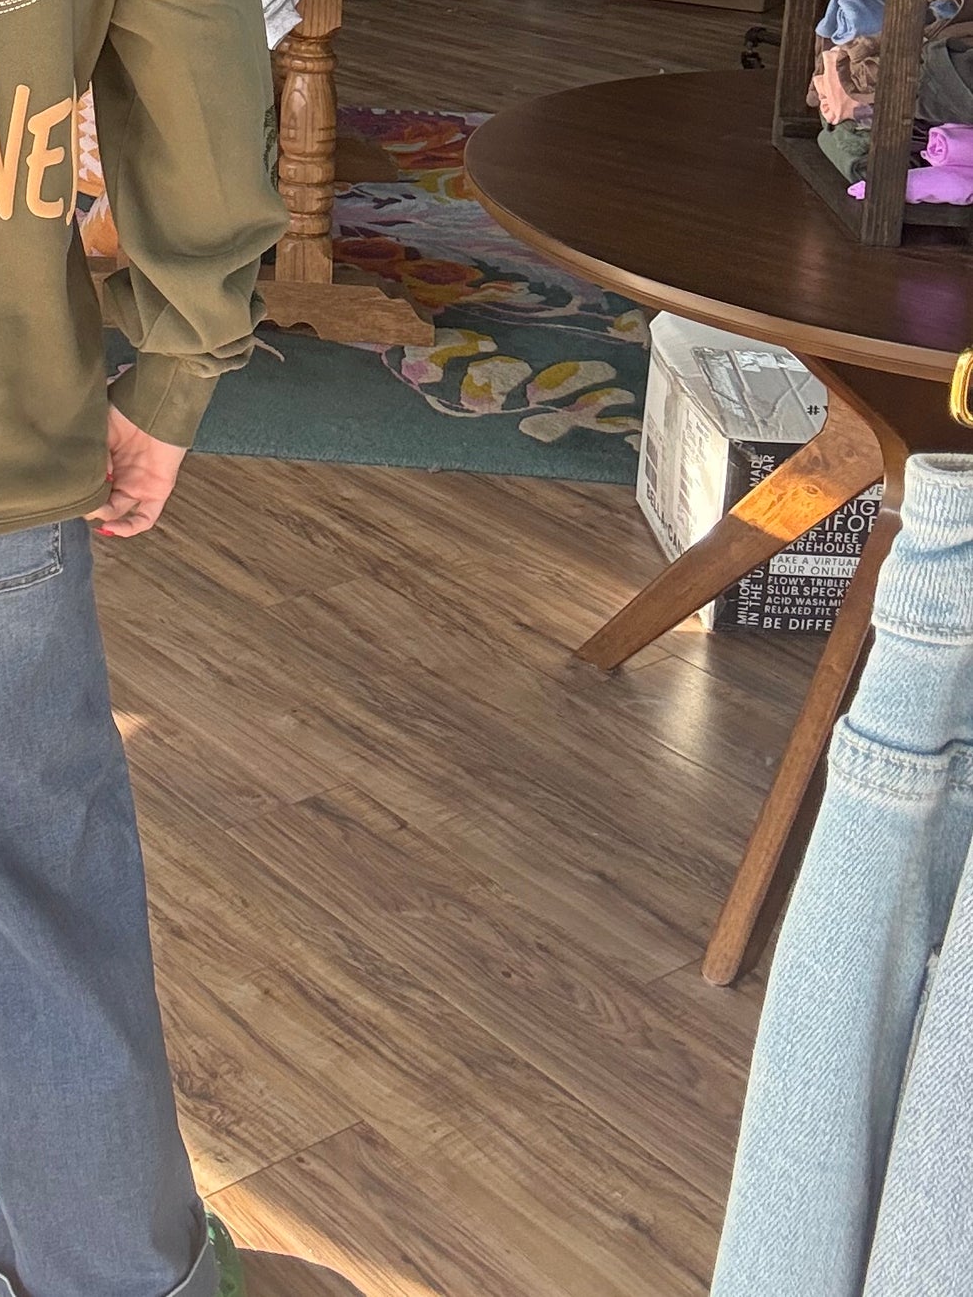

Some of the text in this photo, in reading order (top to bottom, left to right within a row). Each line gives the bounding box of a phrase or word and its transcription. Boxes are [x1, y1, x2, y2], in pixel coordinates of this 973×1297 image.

[837, 500, 876, 516] NG
[802, 532, 859, 544] ER-FREE
[787, 542, 862, 555] AREHOUSE
[801, 557, 810, 565] A
[814, 557, 858, 567] VIRTUAL
[771, 564, 805, 575] TOUR
[810, 578, 852, 588] TRIBLEN
[749, 584, 763, 607] THE
[803, 586, 849, 598] SPECK
[765, 596, 792, 605] ACID
[764, 605, 812, 616] RELAXED
[747, 612, 759, 625] IN
[762, 616, 782, 629] BE
